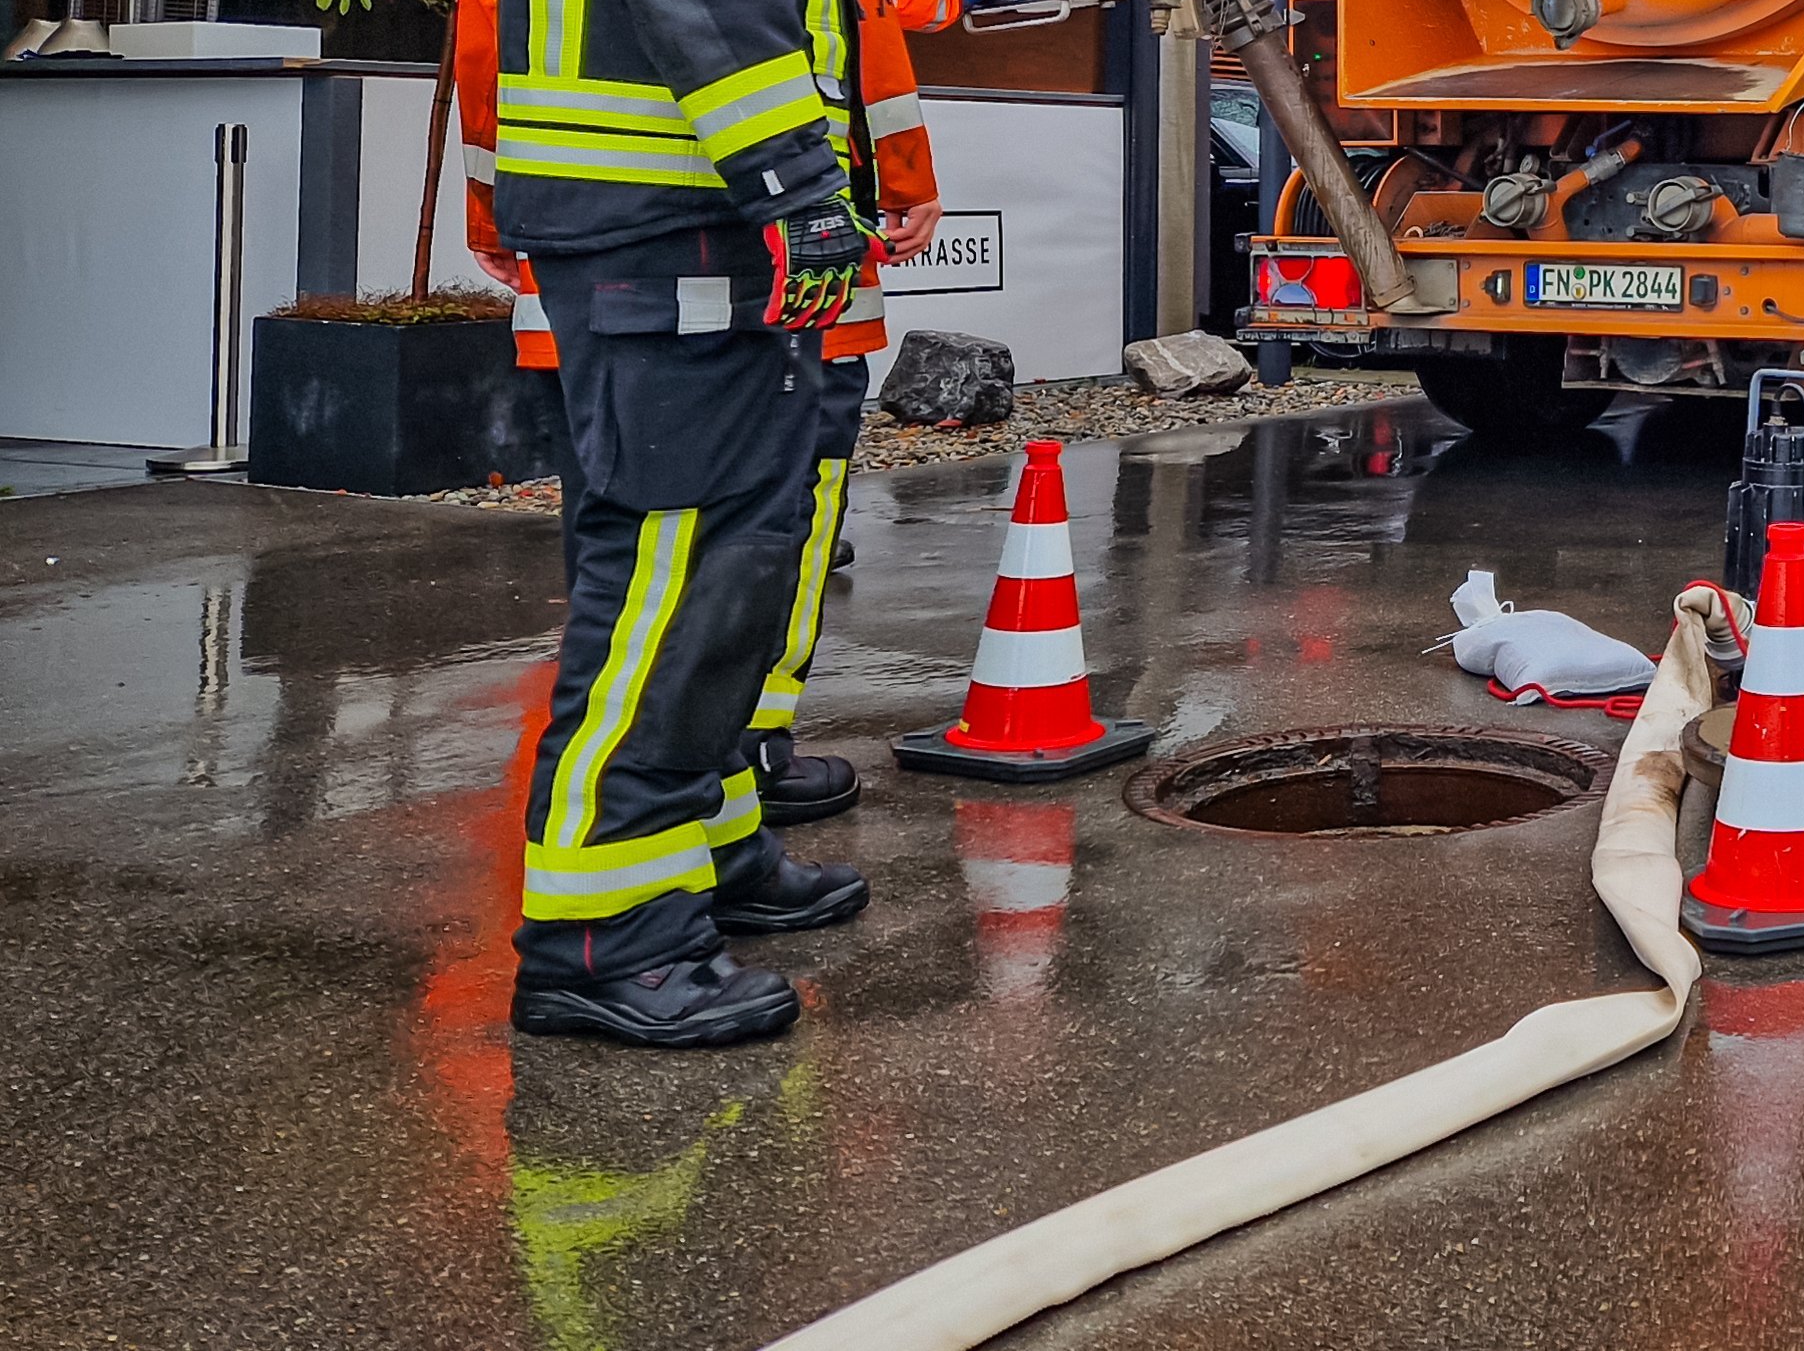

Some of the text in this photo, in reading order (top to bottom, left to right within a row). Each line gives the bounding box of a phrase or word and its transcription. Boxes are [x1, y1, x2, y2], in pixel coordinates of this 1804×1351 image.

[1542, 268, 1570, 296] FN
[1588, 269, 1616, 297] PK
[1621, 271, 1678, 299] 2844
